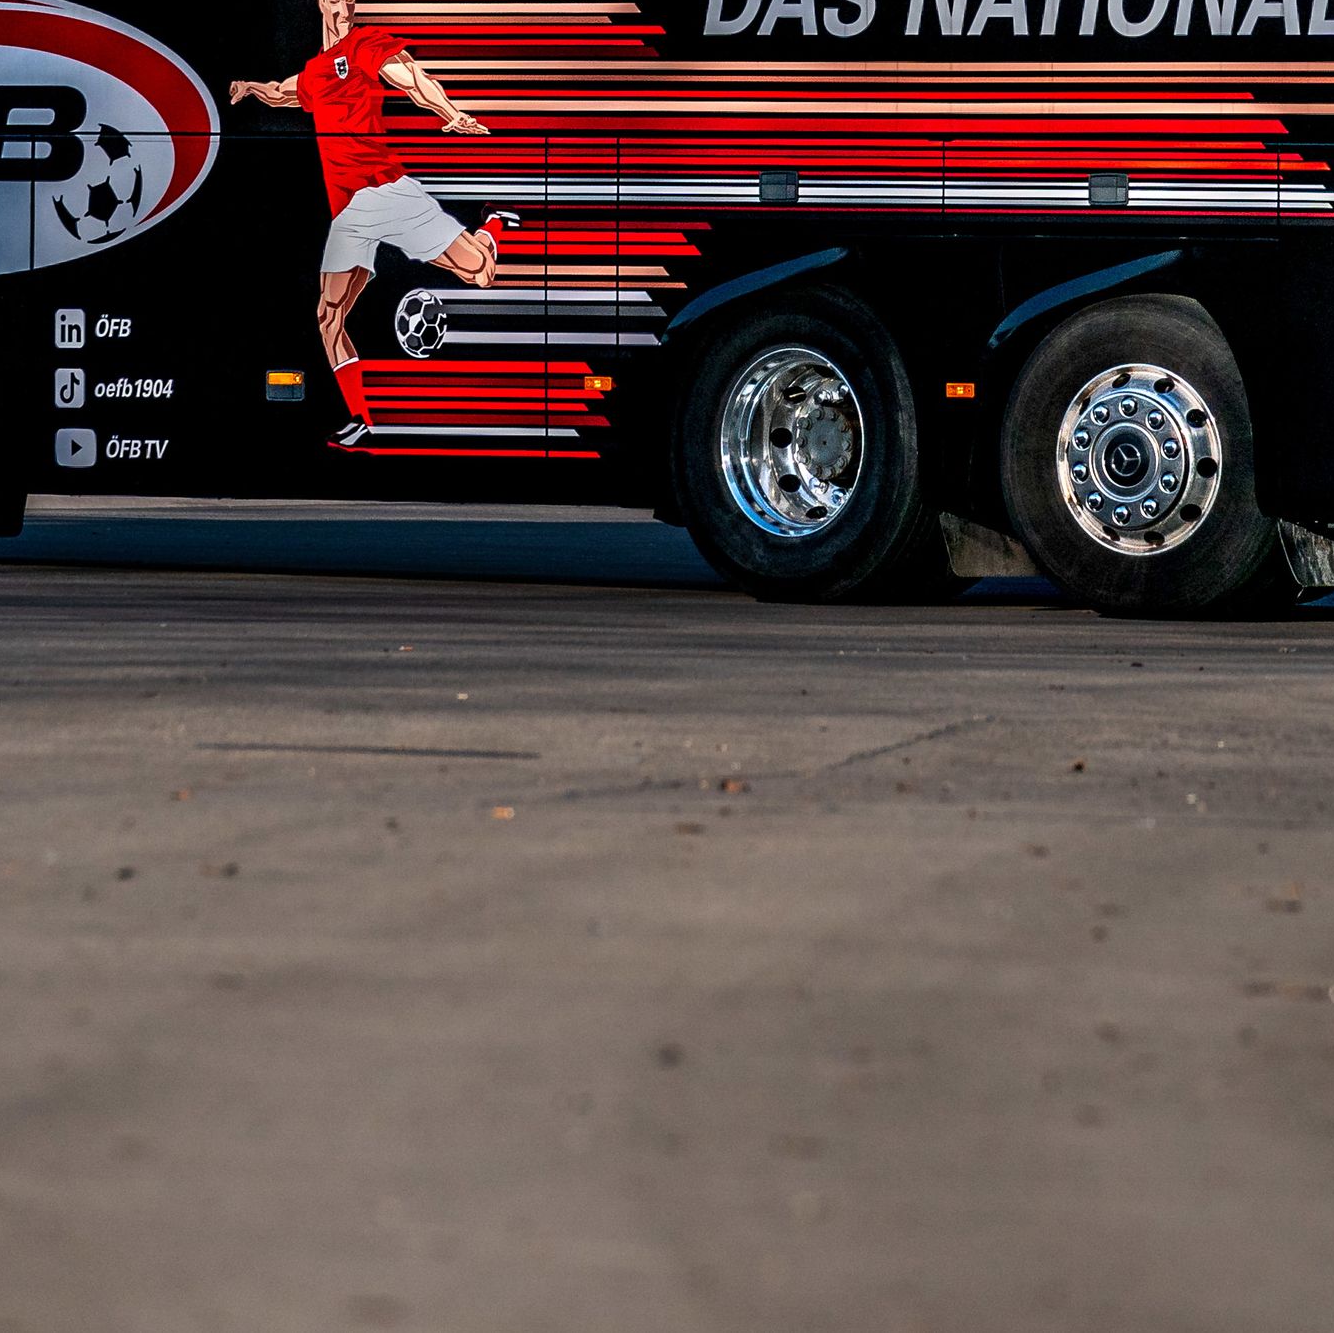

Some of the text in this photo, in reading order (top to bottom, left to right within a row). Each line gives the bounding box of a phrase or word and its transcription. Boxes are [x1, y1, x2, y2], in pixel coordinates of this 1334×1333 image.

[95, 314, 132, 338] ÖFB
[94, 377, 174, 399] oefb1904
[105, 434, 169, 459] ÖFB TV
